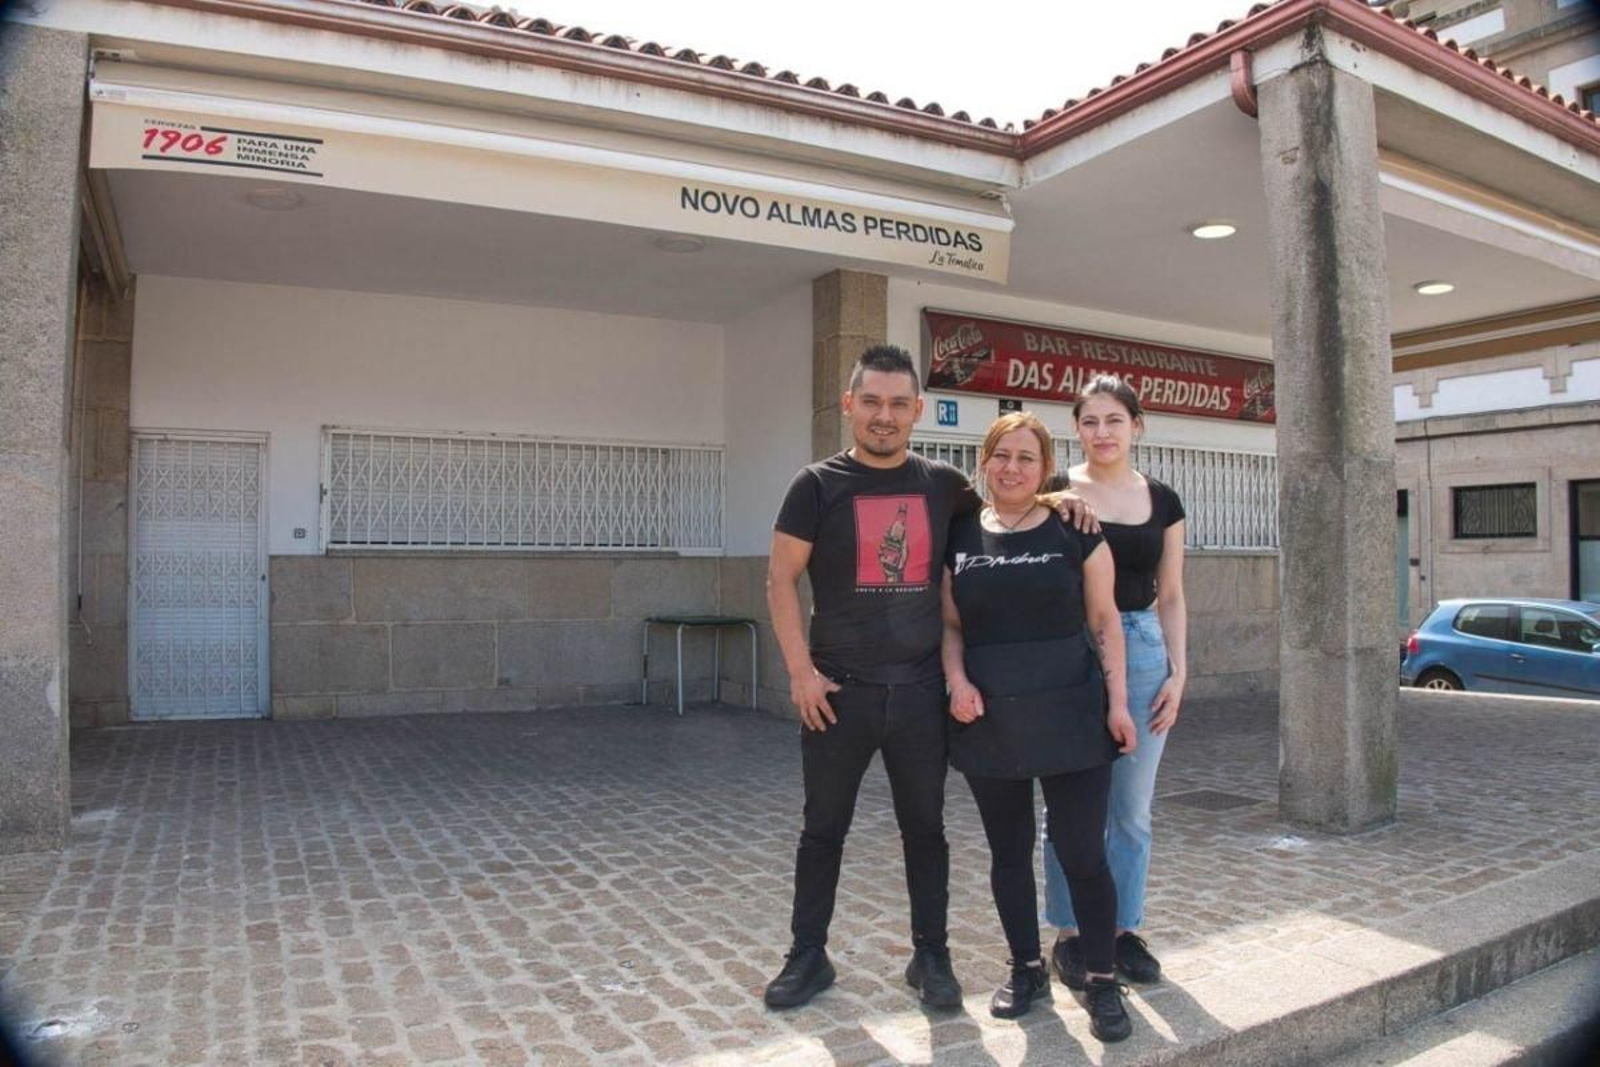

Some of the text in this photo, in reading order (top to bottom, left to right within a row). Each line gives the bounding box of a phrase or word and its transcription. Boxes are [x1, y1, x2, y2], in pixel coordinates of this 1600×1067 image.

[143, 128, 227, 156] 1906
[236, 145, 310, 161] INMENSA
[237, 137, 317, 154] PARA UNA
[235, 153, 307, 169] MINORIA
[680, 186, 983, 252] NOVO ALMAS PERDIDAS
[1022, 332, 1218, 376] BAR-RESTAURANTE
[1006, 358, 1055, 393] DAS
[1138, 375, 1233, 412] PERDIDAS
